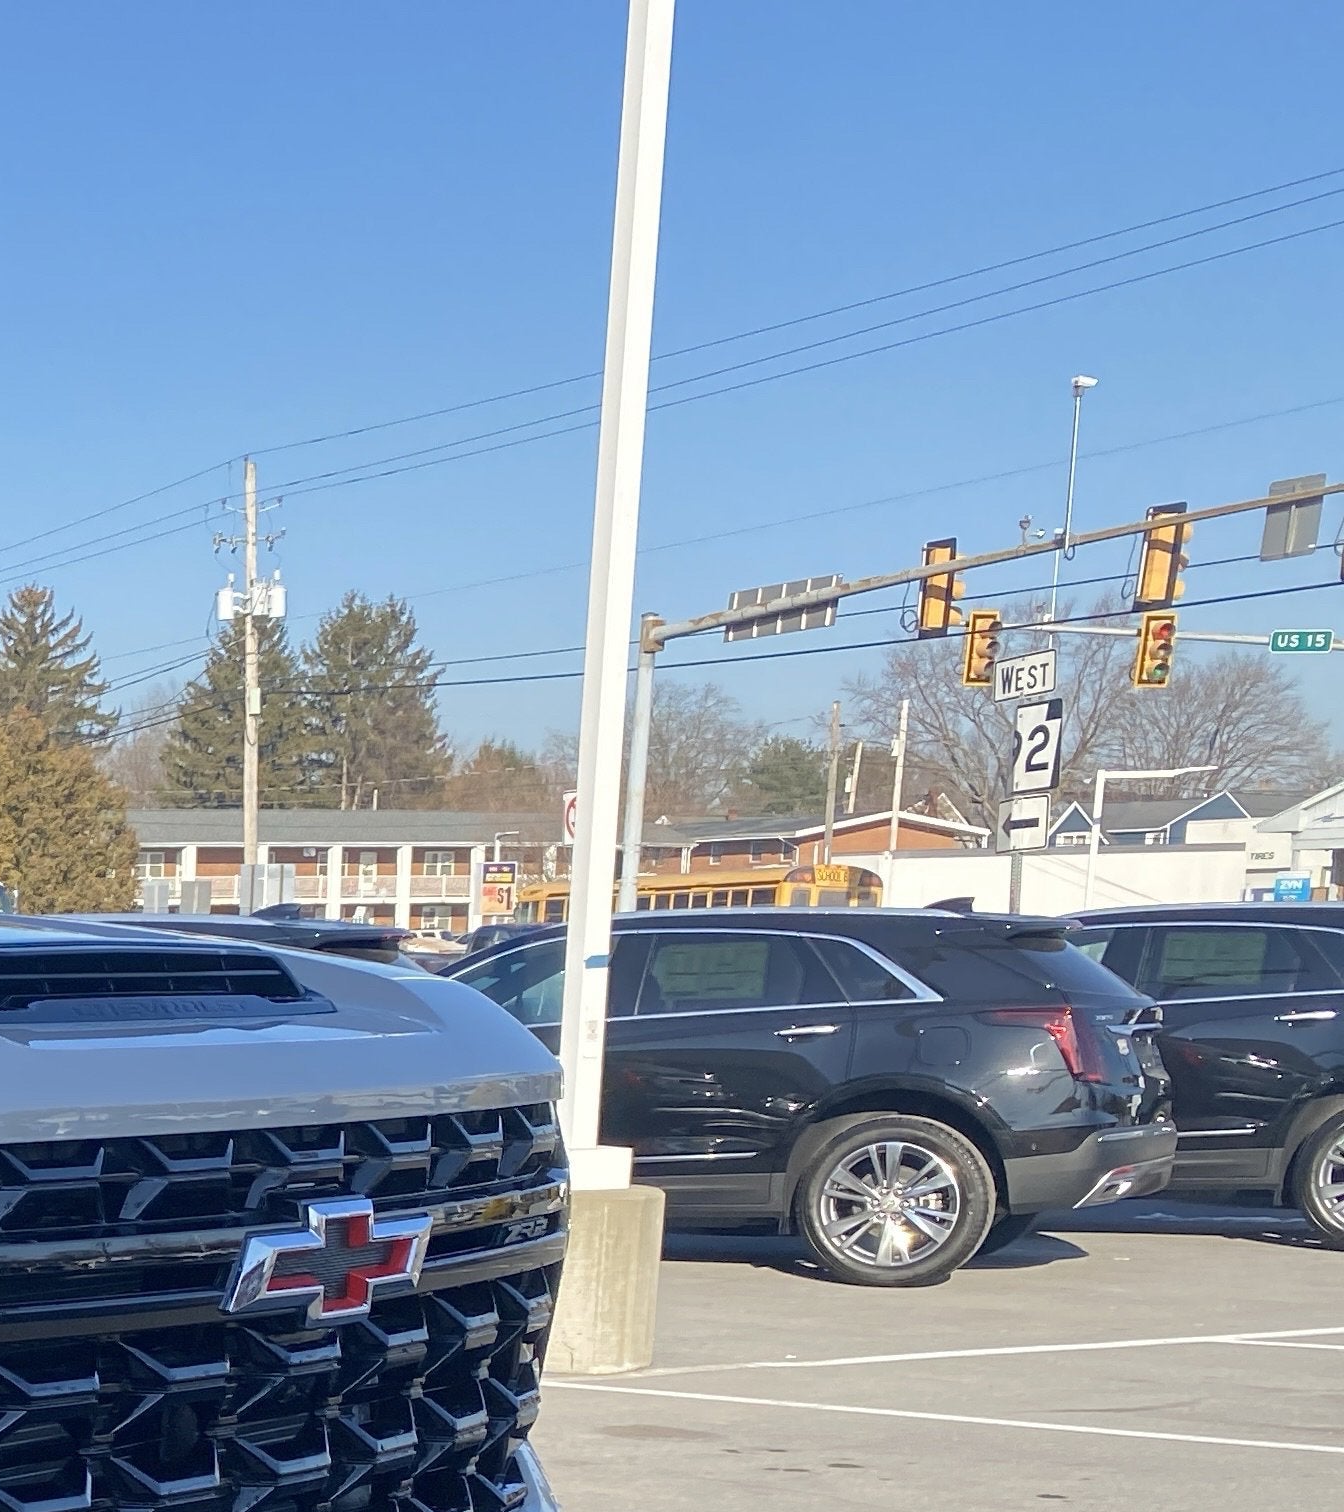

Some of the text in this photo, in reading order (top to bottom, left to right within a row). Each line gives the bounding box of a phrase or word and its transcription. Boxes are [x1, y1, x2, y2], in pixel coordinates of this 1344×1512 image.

[1277, 634, 1326, 648] US 15
[1001, 662, 1049, 695] WEST
[1250, 852, 1275, 860] TIRES
[1279, 879, 1303, 890] ZYN
[72, 999, 248, 1019] CHEVROLET
[502, 1215, 550, 1246] ZR2
